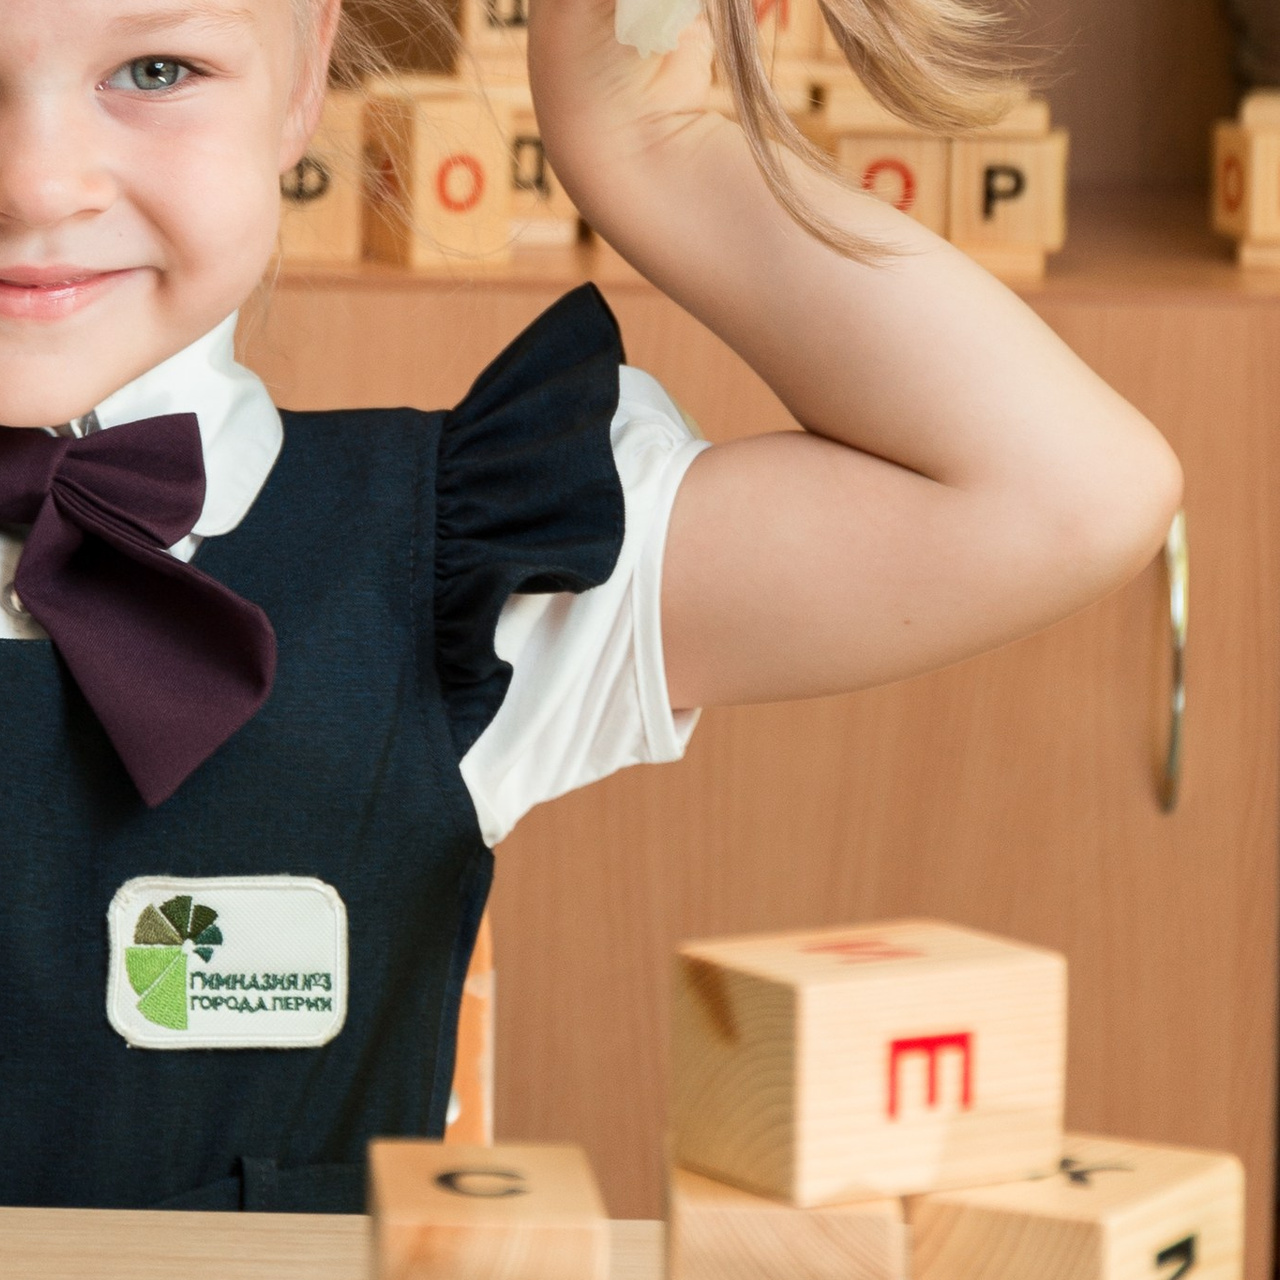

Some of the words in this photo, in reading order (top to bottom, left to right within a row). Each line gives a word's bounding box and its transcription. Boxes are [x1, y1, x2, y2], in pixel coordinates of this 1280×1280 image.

[434, 153, 486, 212] О
[981, 164, 1025, 220] Р
[190, 971, 299, 991] ГИМНАЗИЯ
[190, 995, 269, 1013] ГОРОДА
[272, 996, 332, 1012] ПЕРМИ
[887, 1031, 973, 1122] Е
[434, 1167, 529, 1198] С
